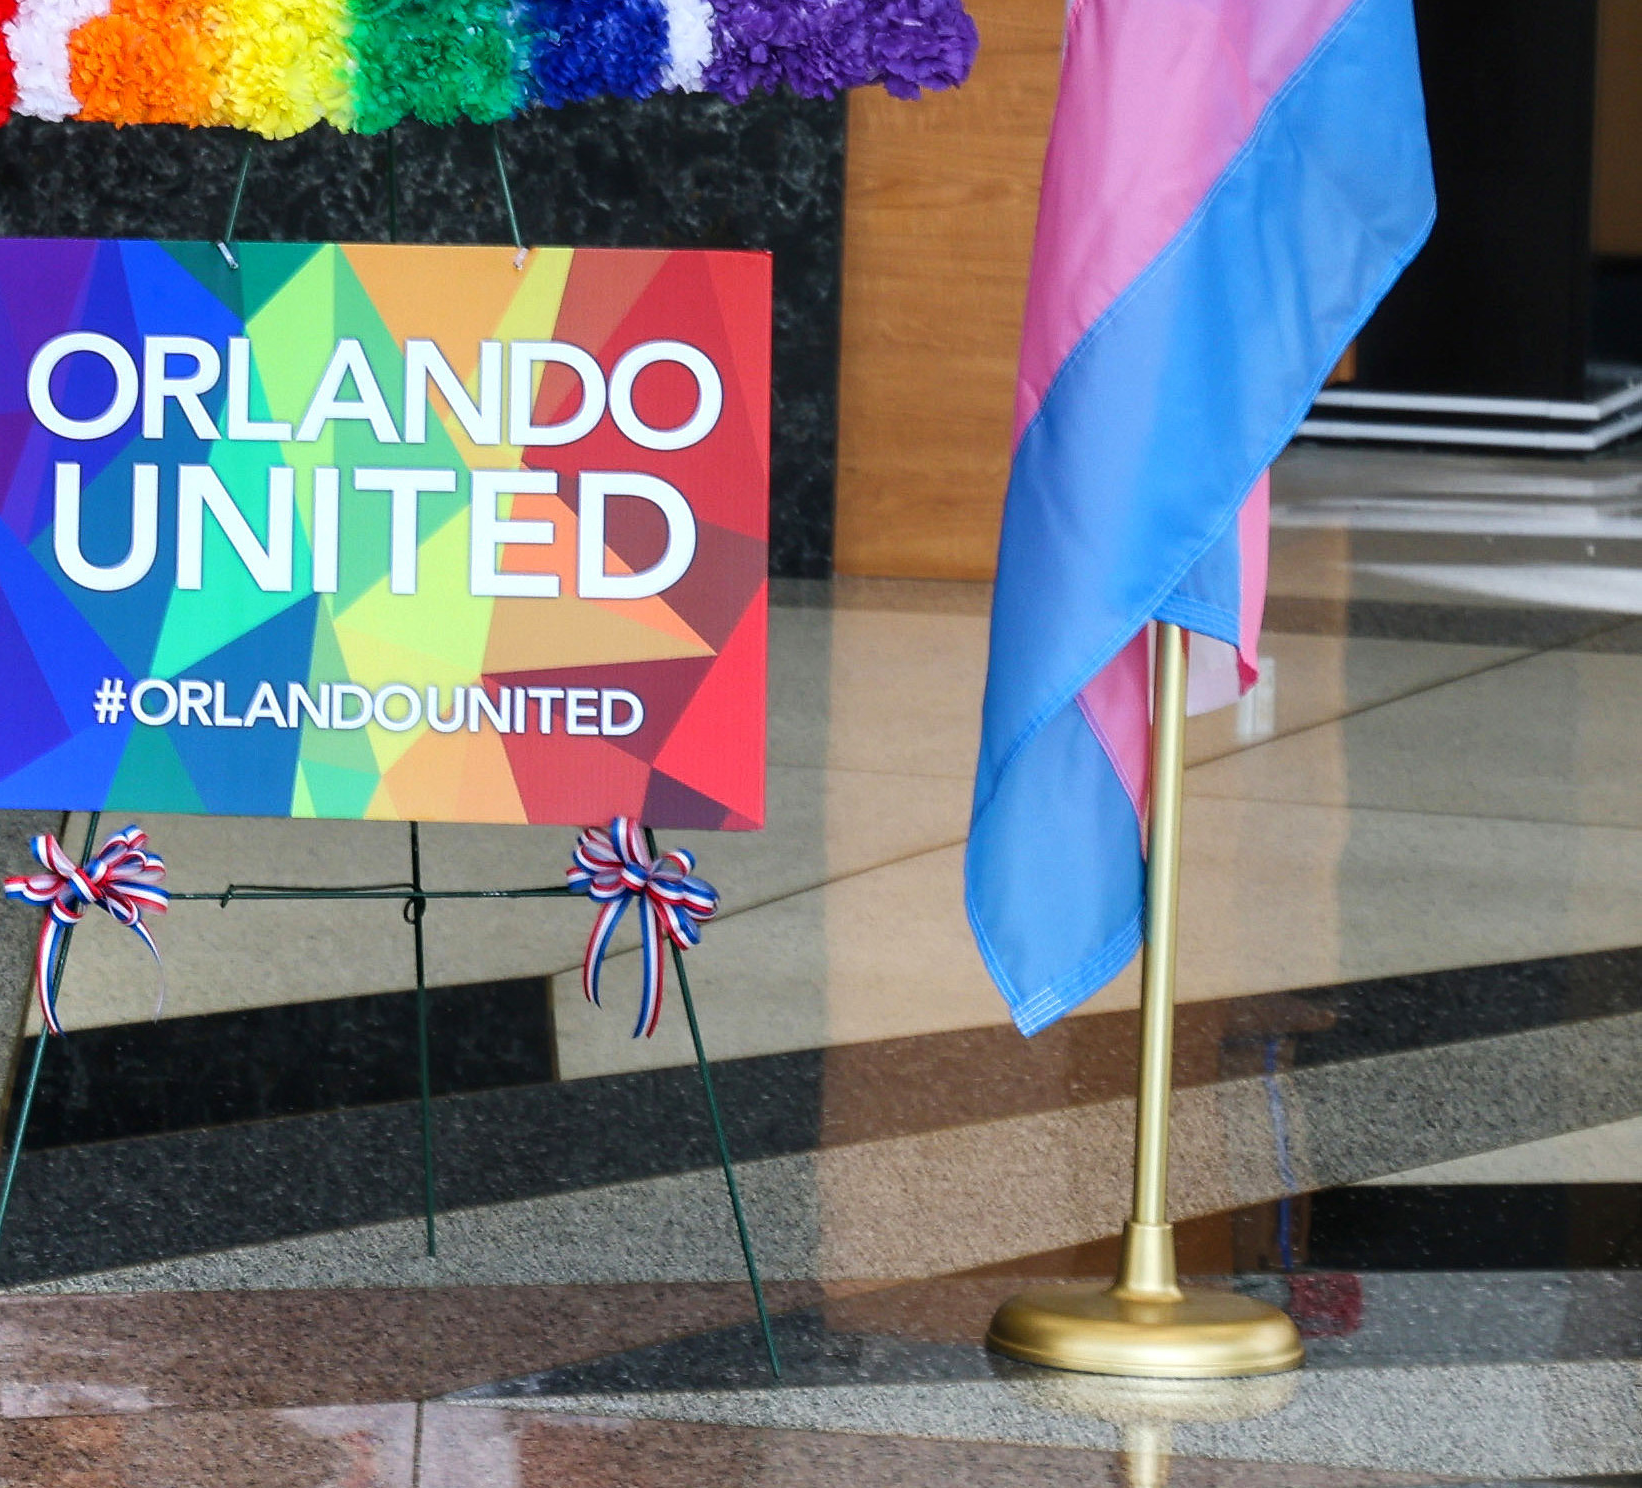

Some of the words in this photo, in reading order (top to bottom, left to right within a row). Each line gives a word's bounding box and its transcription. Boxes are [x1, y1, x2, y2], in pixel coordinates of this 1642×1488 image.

[25, 330, 724, 452] ORLANDO
[52, 461, 697, 601] UNITED
[93, 676, 645, 737] #ORLANDOUNITED
